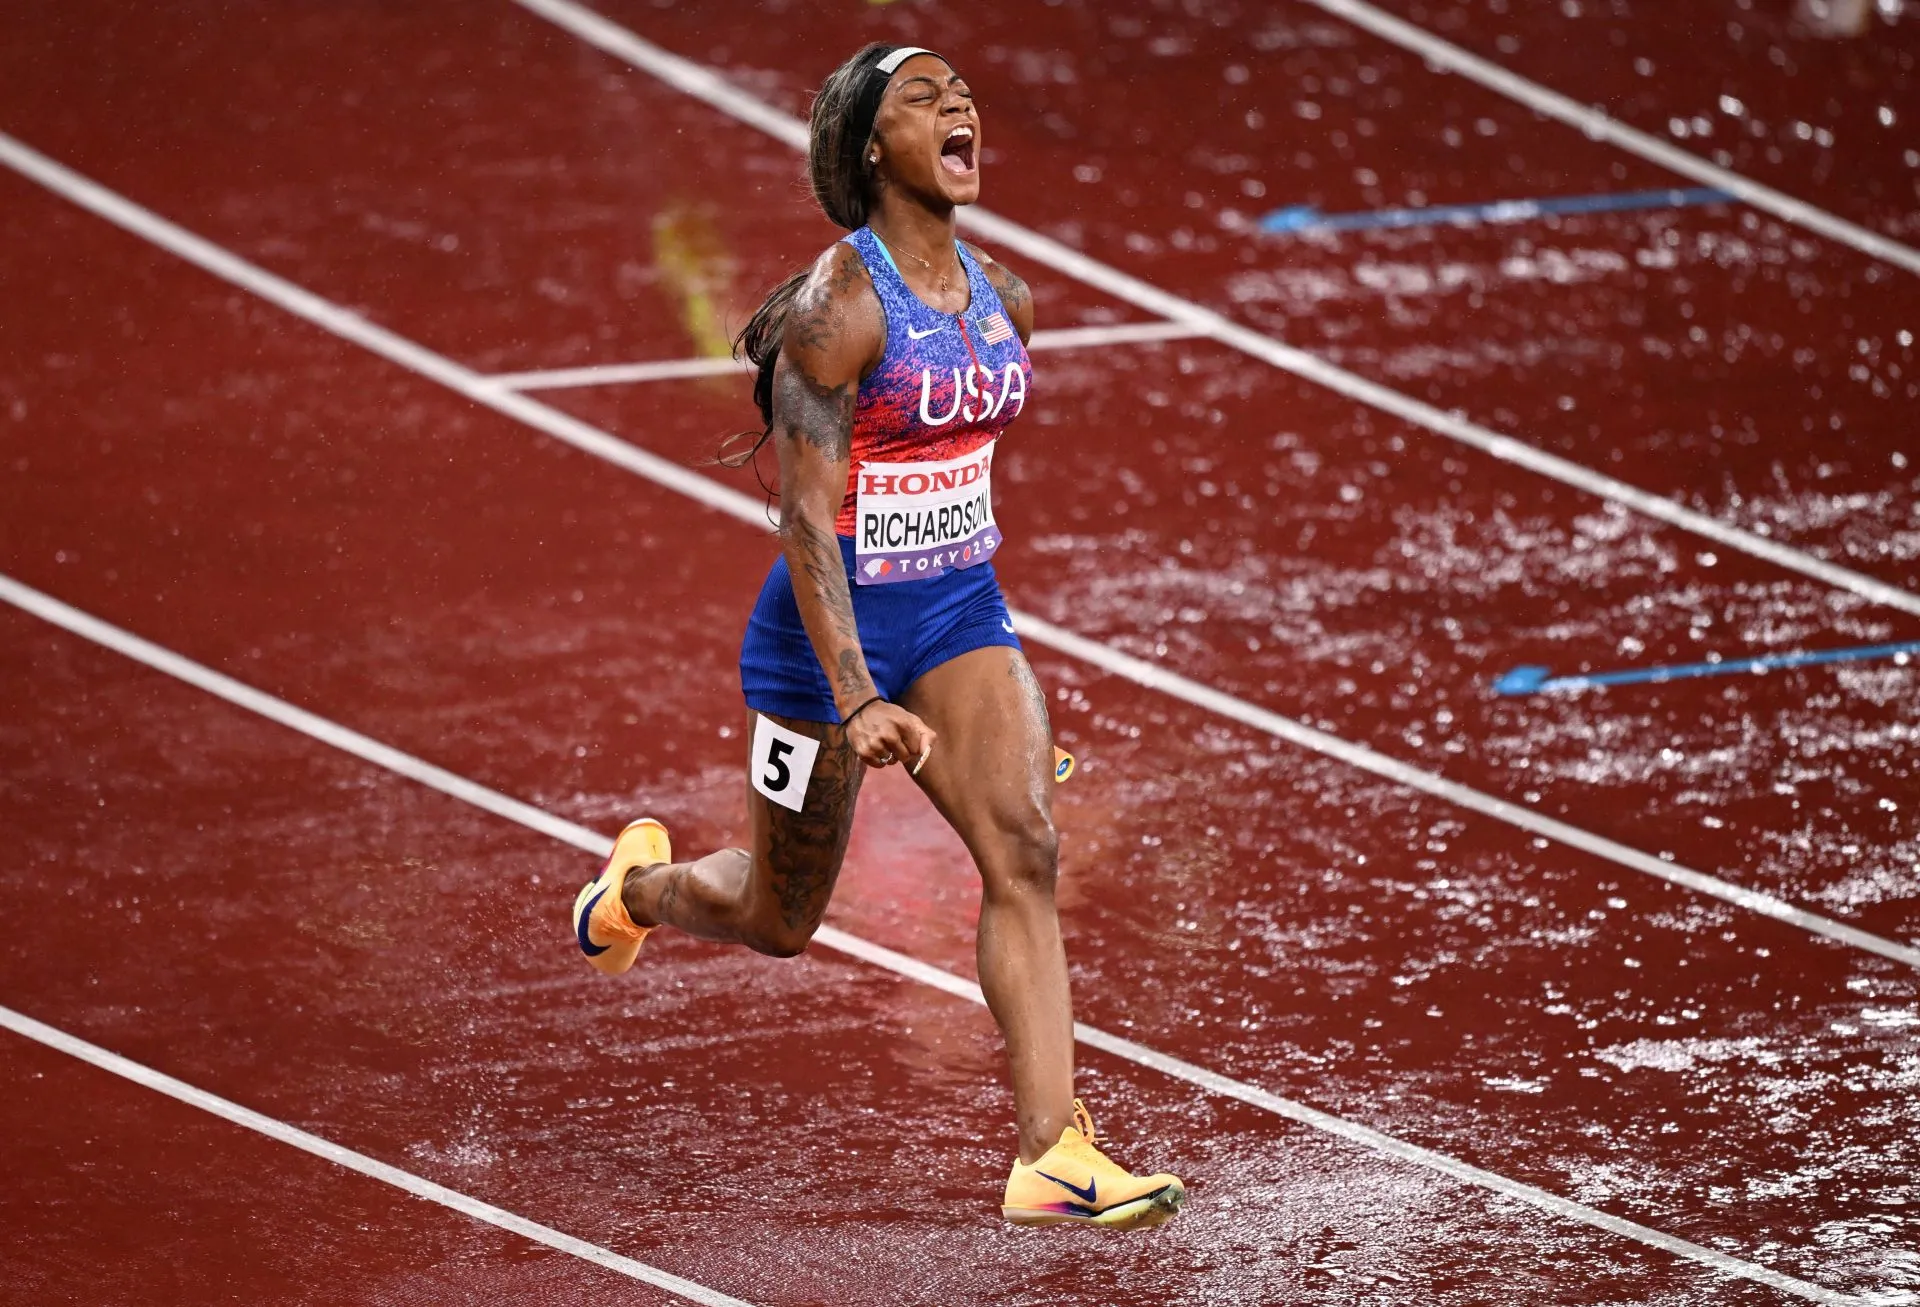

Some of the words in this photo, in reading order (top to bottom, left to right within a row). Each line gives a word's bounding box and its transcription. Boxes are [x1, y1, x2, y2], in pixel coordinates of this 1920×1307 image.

[919, 361, 1026, 426] USA
[861, 455, 989, 496] HONDA
[863, 488, 988, 549] RICHARDSON
[763, 737, 795, 792] 5
